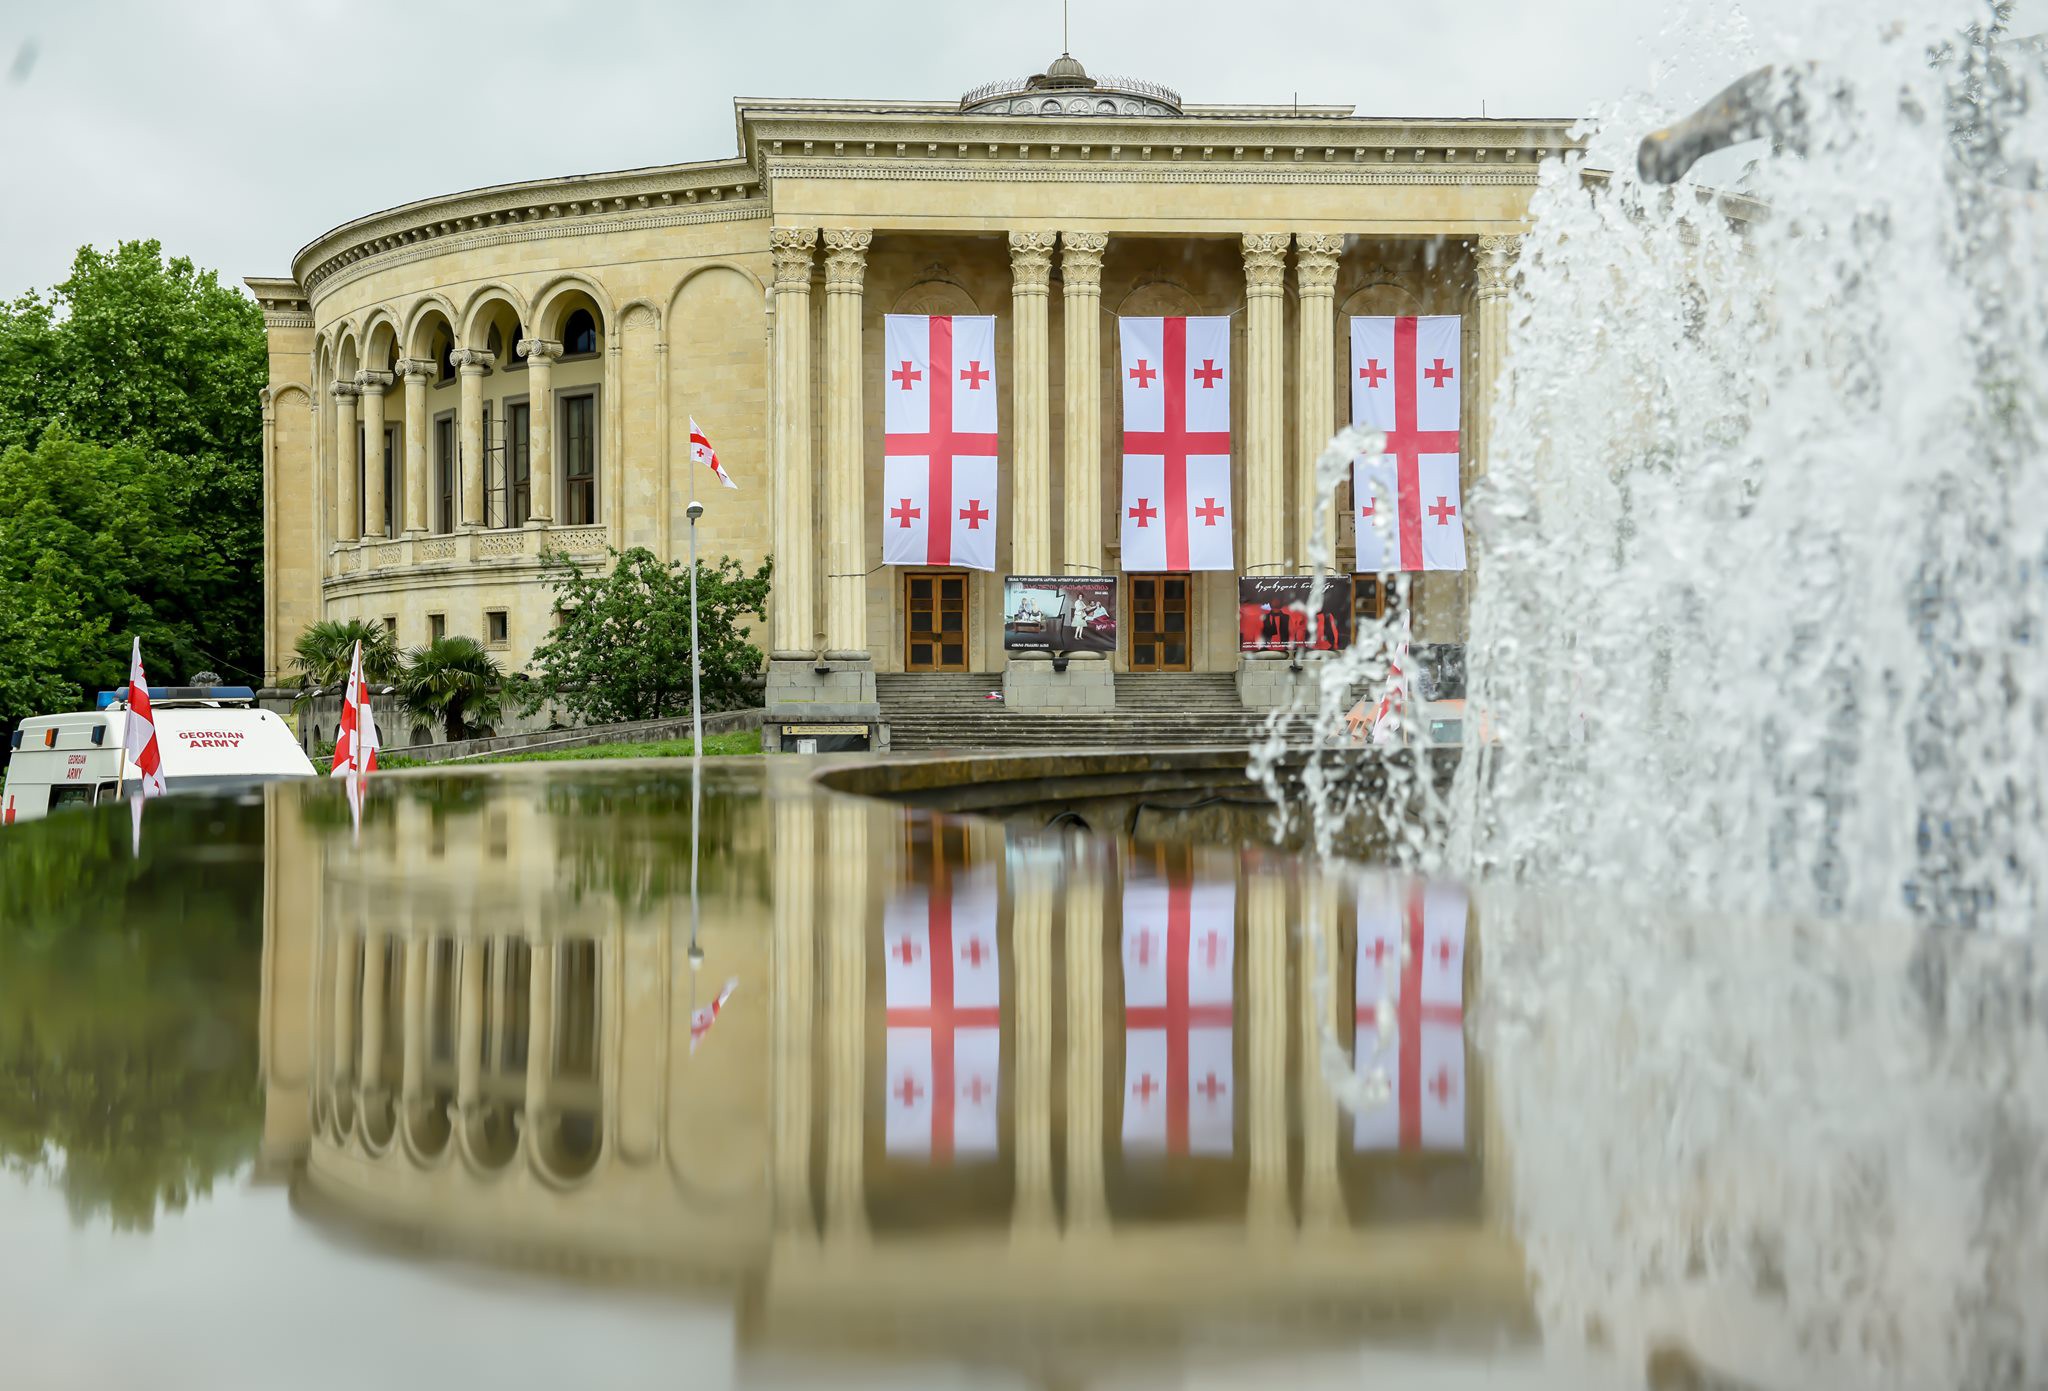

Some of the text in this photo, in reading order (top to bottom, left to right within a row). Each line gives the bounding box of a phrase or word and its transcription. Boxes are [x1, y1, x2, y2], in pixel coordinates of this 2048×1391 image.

[179, 731, 244, 740] GEORGIAN
[190, 739, 240, 748] ARMY
[68, 755, 87, 764] GEORGIAN
[66, 768, 83, 779] ARMY
